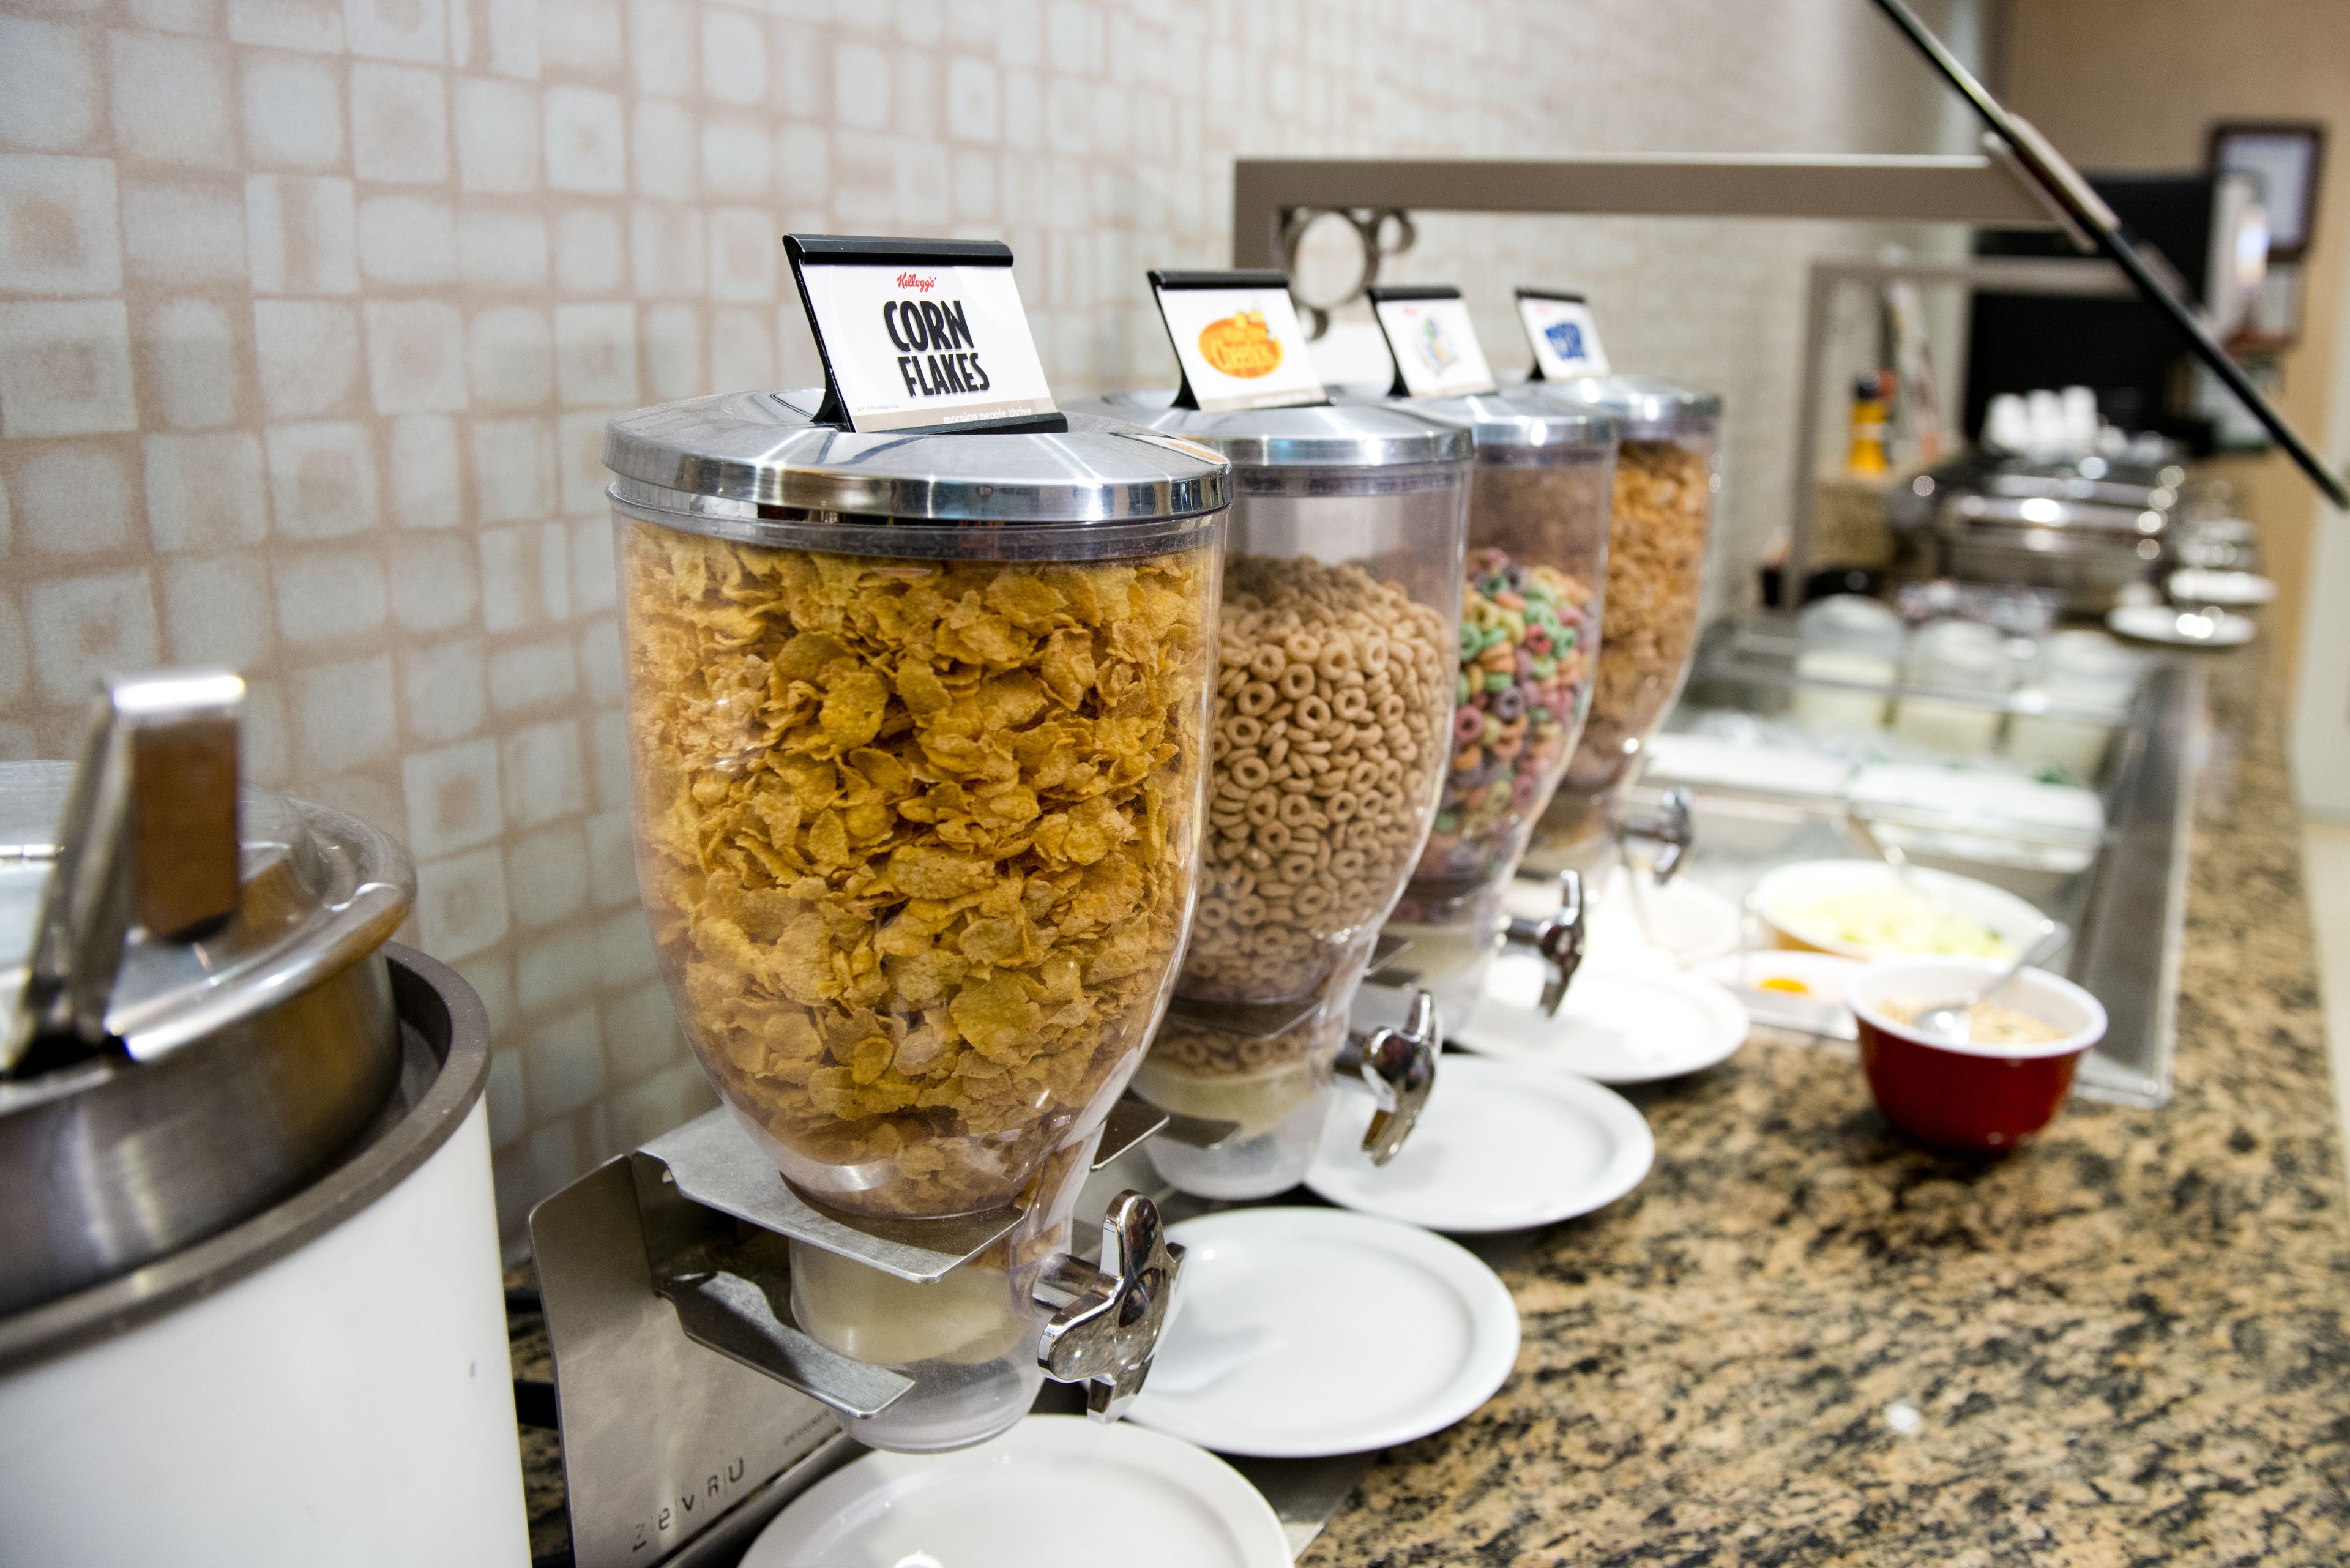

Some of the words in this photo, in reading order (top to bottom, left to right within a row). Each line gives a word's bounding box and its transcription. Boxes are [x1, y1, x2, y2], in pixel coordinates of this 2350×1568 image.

[897, 272, 934, 293] Kellogg's
[884, 300, 974, 352] CORN
[897, 353, 990, 397] FLAKES
[1008, 406, 1032, 417] thrive
